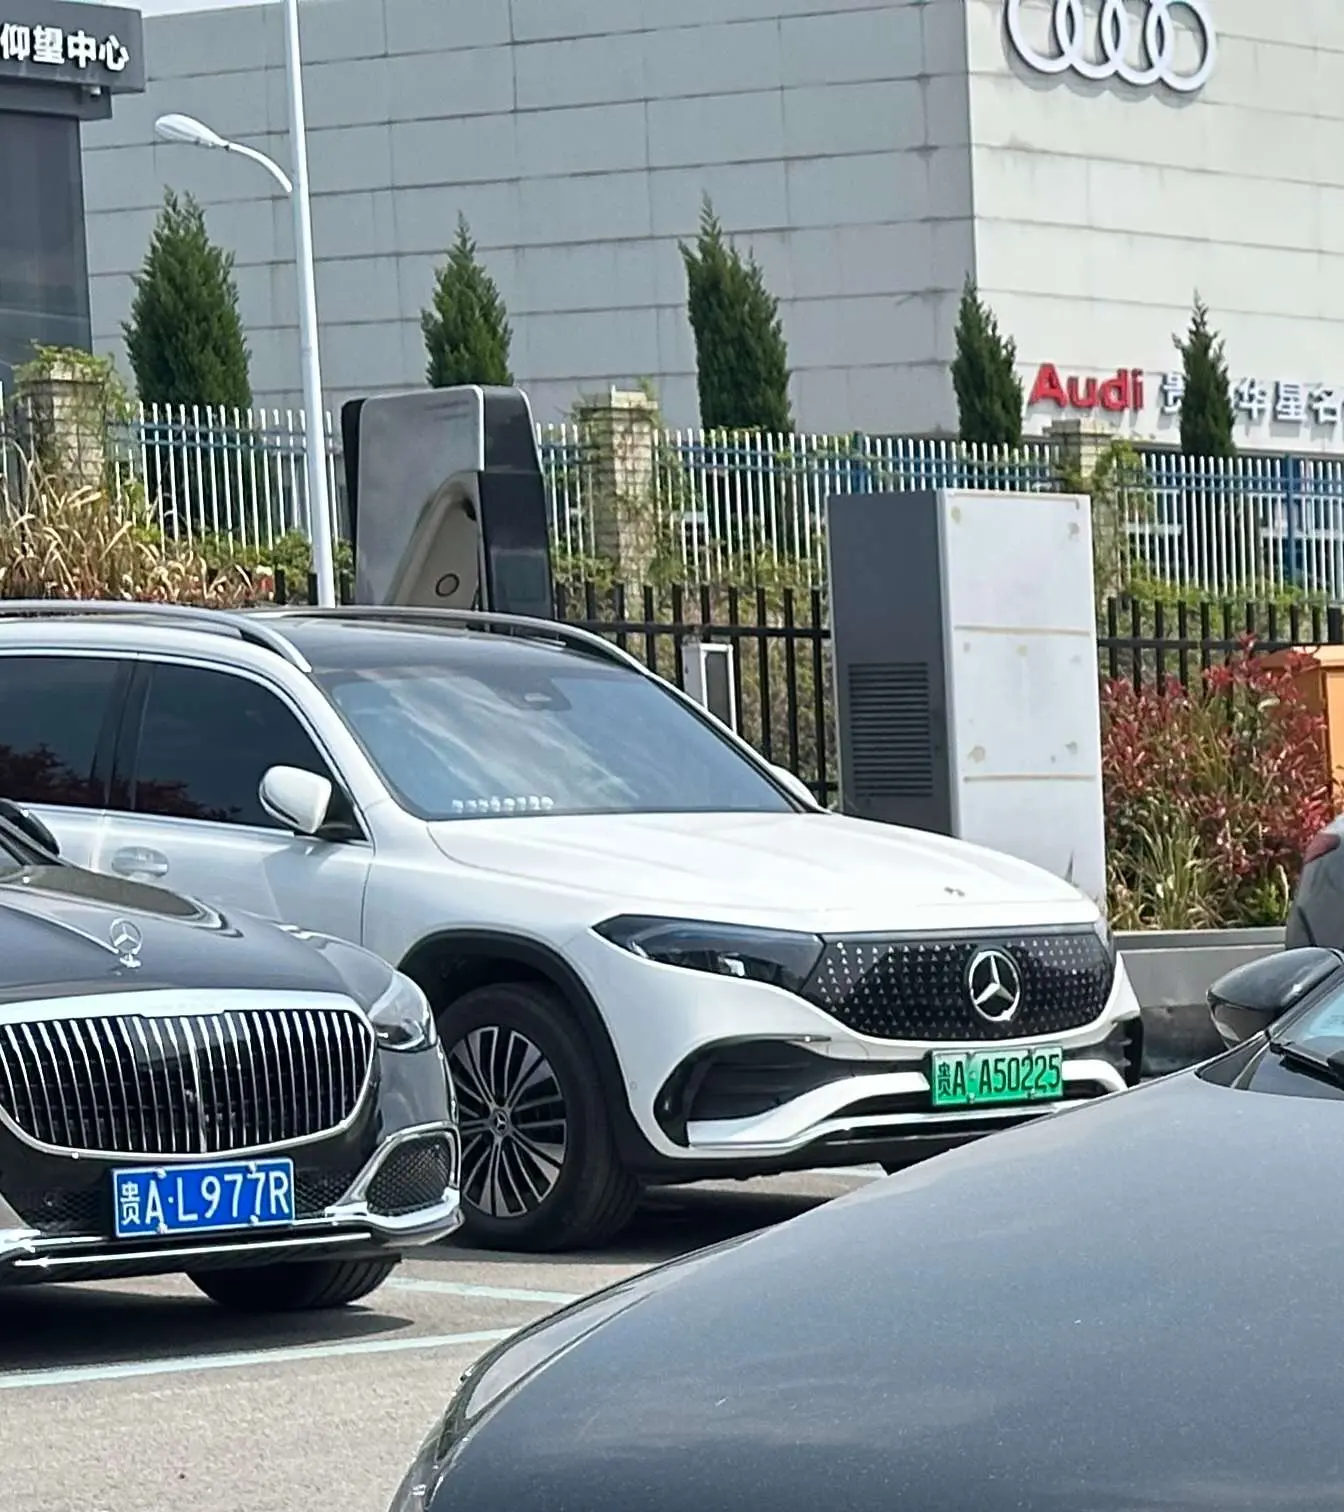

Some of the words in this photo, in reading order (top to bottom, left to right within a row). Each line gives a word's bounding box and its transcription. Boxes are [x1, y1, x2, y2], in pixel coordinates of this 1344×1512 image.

[0, 22, 130, 71] 仰望中心
[1028, 362, 1144, 412] Audi
